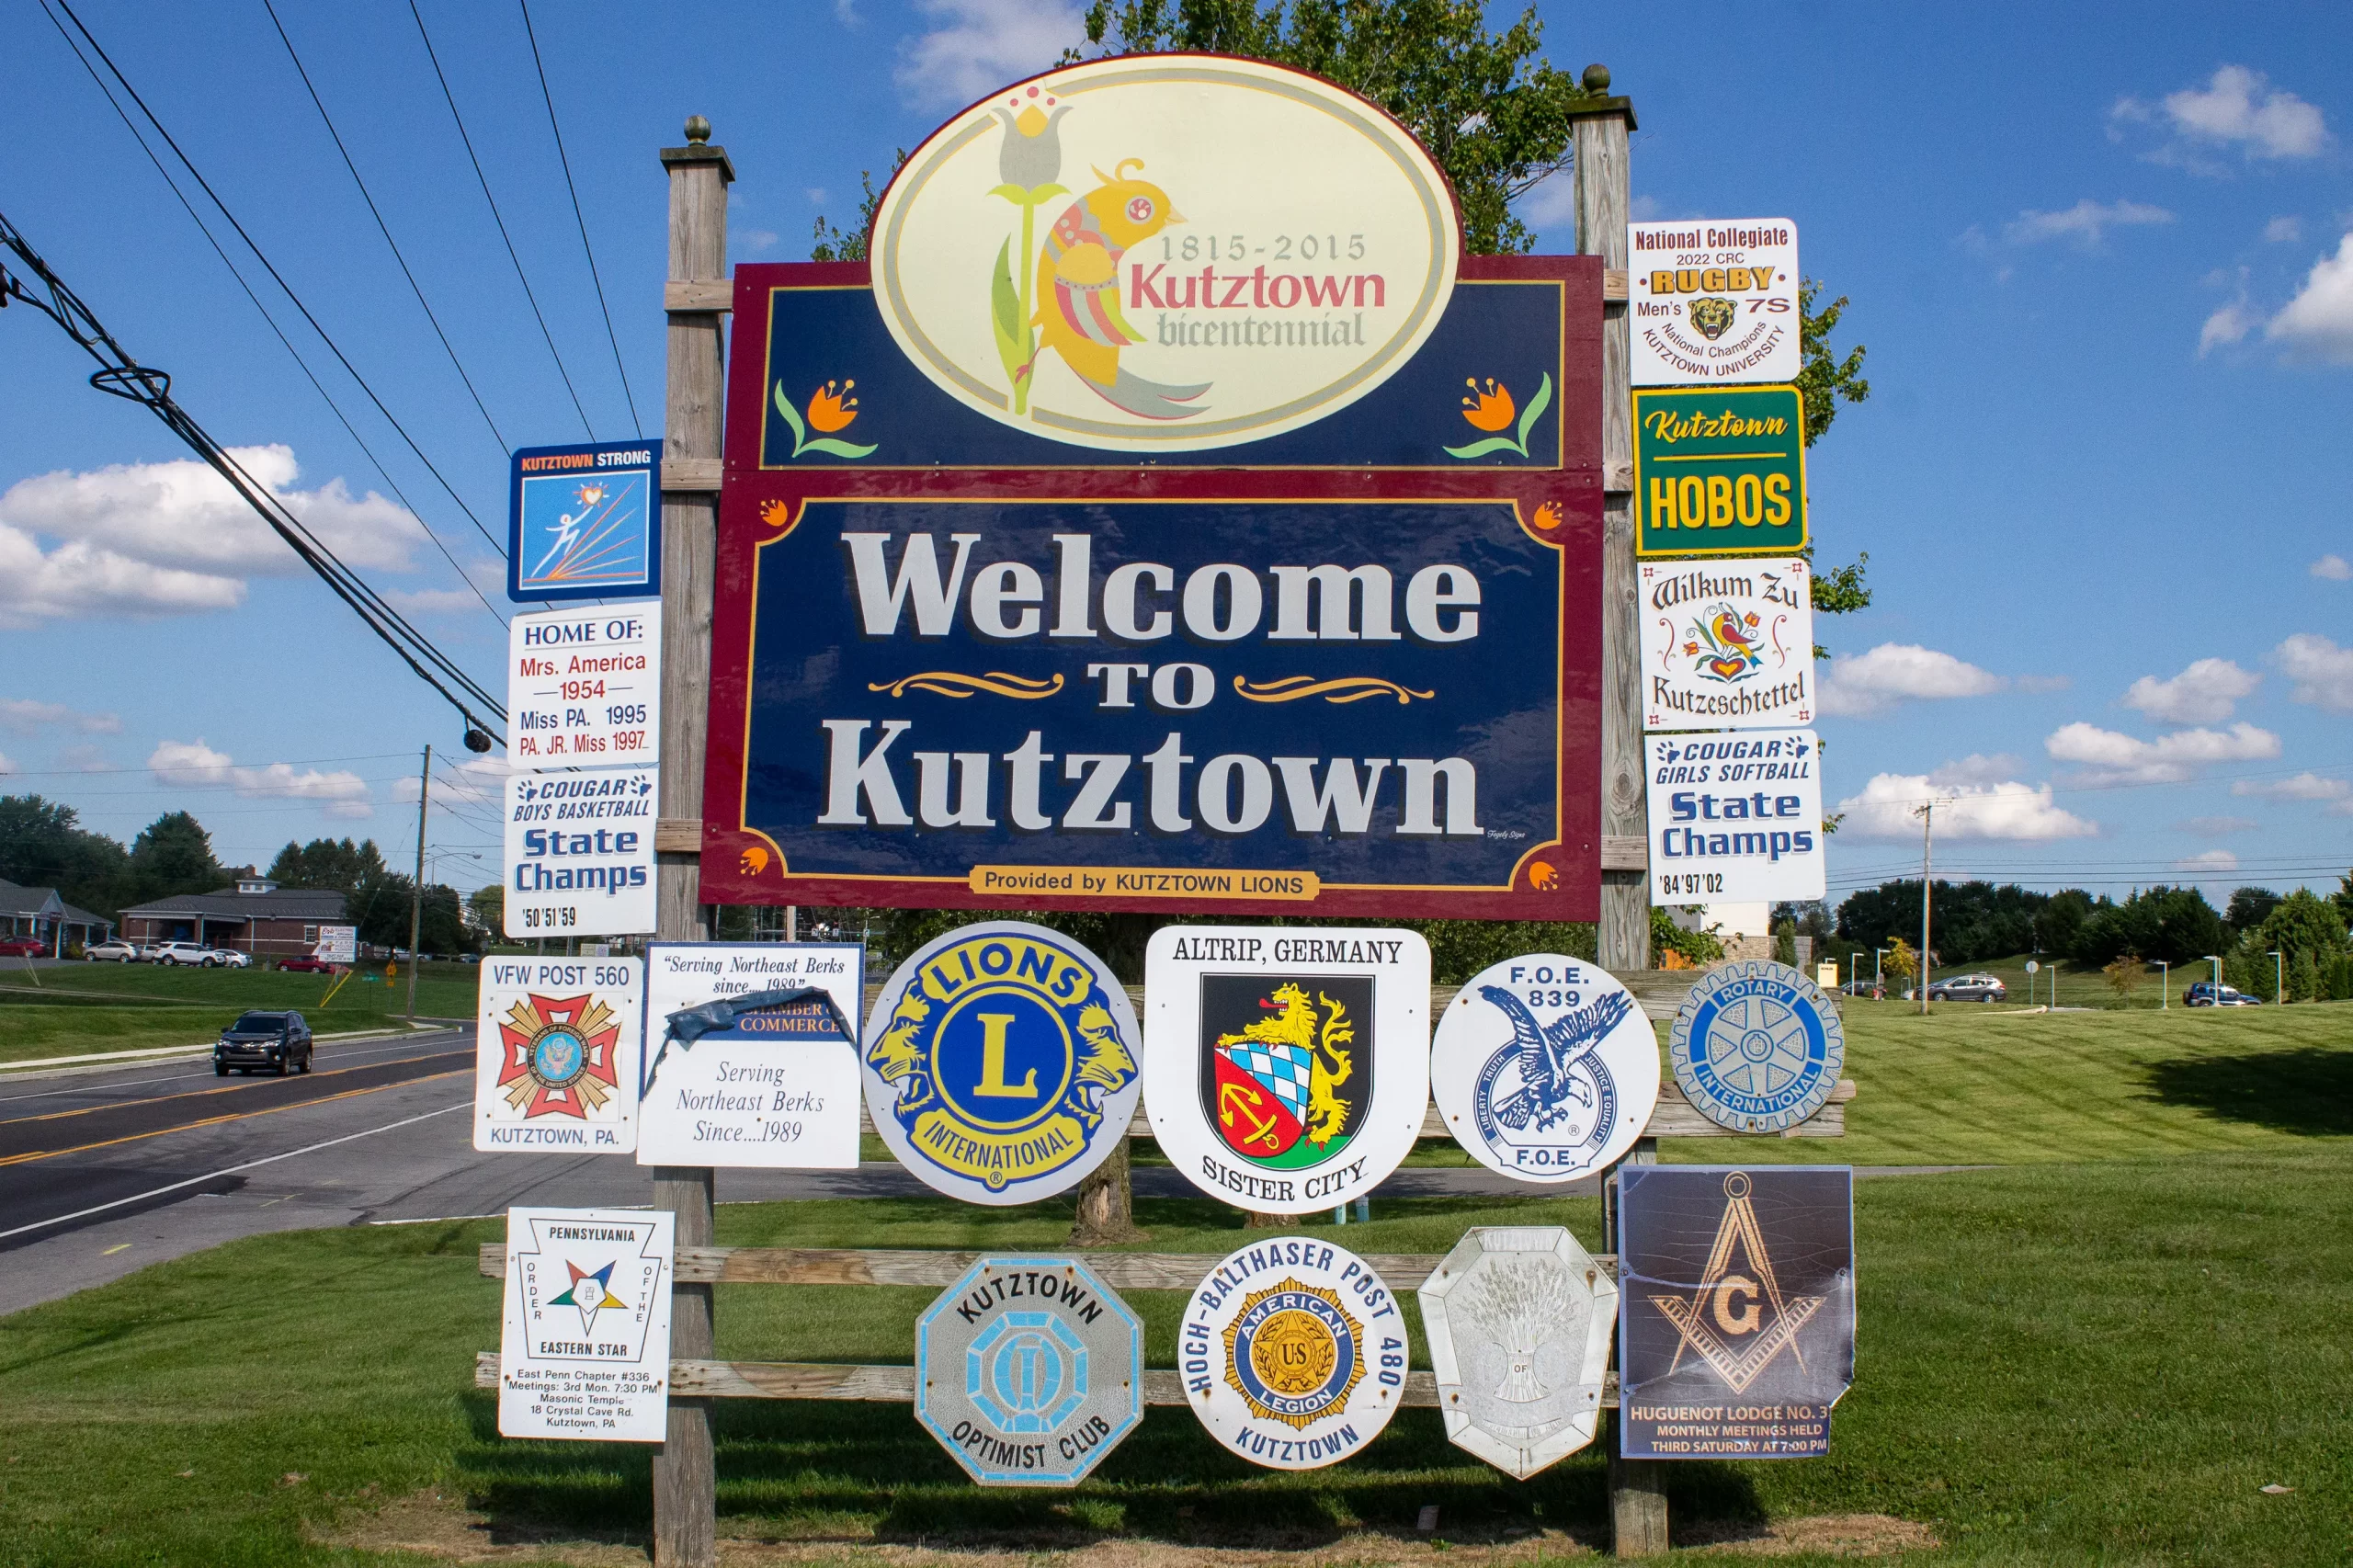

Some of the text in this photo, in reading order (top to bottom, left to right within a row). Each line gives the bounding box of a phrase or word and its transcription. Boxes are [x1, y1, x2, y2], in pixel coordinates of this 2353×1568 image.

[1161, 233, 1365, 261] 1815-2015
[1636, 227, 1788, 250] National Collegiate
[1677, 253, 1745, 266] 2022 CRC
[1131, 263, 1385, 309] Kutztown
[1651, 266, 1775, 294] RUGBY
[1637, 301, 1681, 316] Men's
[1157, 312, 1367, 347] bicentennial
[1662, 321, 1767, 358] National Champions
[1643, 325, 1785, 376] KUTZTOWN UNIVERSITY
[1644, 409, 1788, 443] Kutztown
[522, 450, 651, 471] KUTZTOWN STRONG
[1650, 472, 1791, 529] HOBOS
[841, 532, 1481, 642] Welcome
[1759, 572, 1799, 609] Zu
[525, 620, 642, 645] HOME OF:
[520, 653, 646, 676] Mrs. America
[559, 680, 606, 700] 1954
[1087, 663, 1215, 709] TO
[520, 704, 646, 730] Miss PA. 1995
[520, 731, 645, 756] PA. JR. Miss 1997
[1684, 740, 1781, 761] COUGAR
[817, 720, 1484, 835] Kutztown
[1656, 762, 1809, 785] GIRLS SOFTBALL
[540, 778, 628, 799] COUGAR
[514, 800, 650, 822] BOYS BASKETBALL
[1670, 791, 1801, 822] State
[525, 828, 639, 858] State
[1662, 827, 1813, 861] Champs
[516, 862, 647, 895] Champs
[984, 871, 1304, 894] Provided by KUTZTOWN LIONS
[1172, 937, 1403, 965] ALTRIP, GERMANY
[494, 965, 630, 986] VFW POST 560
[729, 956, 799, 973] Northeast
[805, 957, 846, 974] Berks
[930, 942, 1083, 998] LIONS
[1510, 966, 1589, 984] F.O.E.
[1529, 990, 1581, 1007] 839
[1721, 980, 1790, 1003] ROTARY
[740, 1017, 840, 1032] COMMERCE
[529, 1028, 550, 1057] VETERANS
[559, 1025, 584, 1040] FOREIGN
[580, 1039, 589, 1058] WARS
[972, 1013, 1039, 1098] L
[530, 1066, 539, 1074] OF
[535, 1074, 547, 1085] THE
[567, 1066, 586, 1085] STATES
[717, 1061, 785, 1086] Serving
[676, 1089, 824, 1112] Northeast Berks
[1478, 1054, 1506, 1131] LIBERTY TRUTH
[1585, 1055, 1612, 1143] JUSTICE EQUALITY
[1699, 1069, 1820, 1113] INTERNATIONAL
[491, 1128, 620, 1147] KUTZTOWN, PA.
[923, 1119, 1074, 1169] INTERNATIONAL
[1516, 1149, 1575, 1165] F.O.E.
[1202, 1154, 1367, 1201] SISTER CITY
[550, 1227, 635, 1242] PENNSYLVANIA
[527, 1262, 542, 1320] ORDER
[956, 1272, 1103, 1325] KUTZTOWN
[1241, 1294, 1347, 1341] AMERICAN
[1713, 1275, 1763, 1335] G
[1340, 1261, 1394, 1319] POST
[1378, 1336, 1404, 1386] 480
[540, 1342, 627, 1357] EASTERN STAR
[517, 1369, 650, 1381] East Penn Chapter #336
[1514, 1364, 1528, 1373] OF
[508, 1381, 658, 1394] Meetings: 3rd Mon. 7:30 PM
[540, 1393, 584, 1403] Masonic
[530, 1404, 634, 1416] 18 Crystal Cave Rd.
[1259, 1389, 1333, 1413] LEGION
[1631, 1406, 1723, 1421] HUGUENOT
[1727, 1406, 1783, 1421] LODGE
[1786, 1405, 1815, 1420] NO.
[547, 1417, 616, 1428] Kutztown, PA
[1657, 1424, 1823, 1437] MONTHLY MEETINGS HELD
[952, 1415, 1110, 1469] OPTIMIST CLUB
[1235, 1424, 1359, 1461] KUTZTOWN
[1652, 1438, 1827, 1452] THIRD SATURDAY AT 7:00 PM
